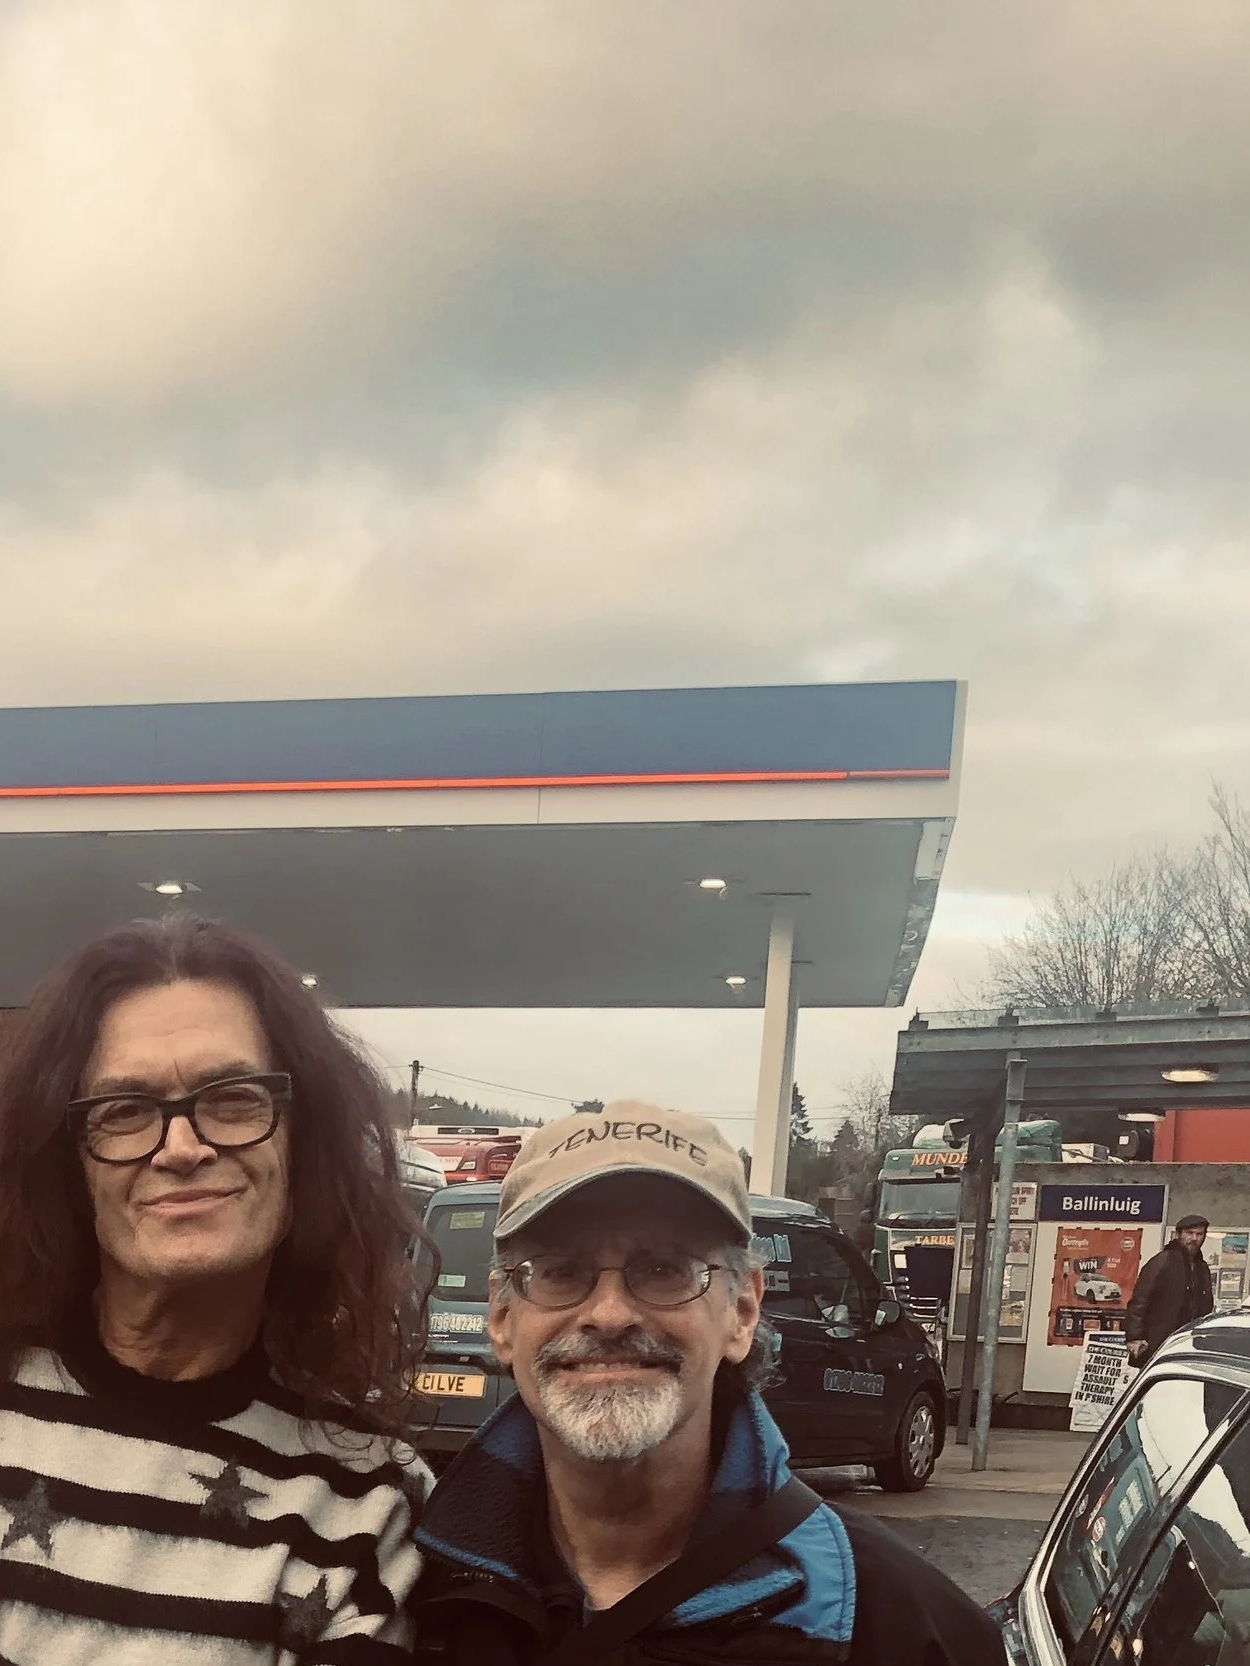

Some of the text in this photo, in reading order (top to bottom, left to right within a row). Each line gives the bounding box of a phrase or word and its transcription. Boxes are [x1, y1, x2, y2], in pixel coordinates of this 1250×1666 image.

[548, 1120, 708, 1167] TENERIFE
[1062, 1196, 1142, 1215] Ballinluig
[914, 1235, 955, 1246] TARBE
[1078, 1259, 1098, 1271] WIN
[1088, 1354, 1123, 1368] 7 MONTH
[1084, 1363, 1122, 1378] WAIT FOR
[1082, 1373, 1119, 1387] ASSAULT
[1074, 1391, 1084, 1401] IN
[1080, 1382, 1116, 1396] THERAPY
